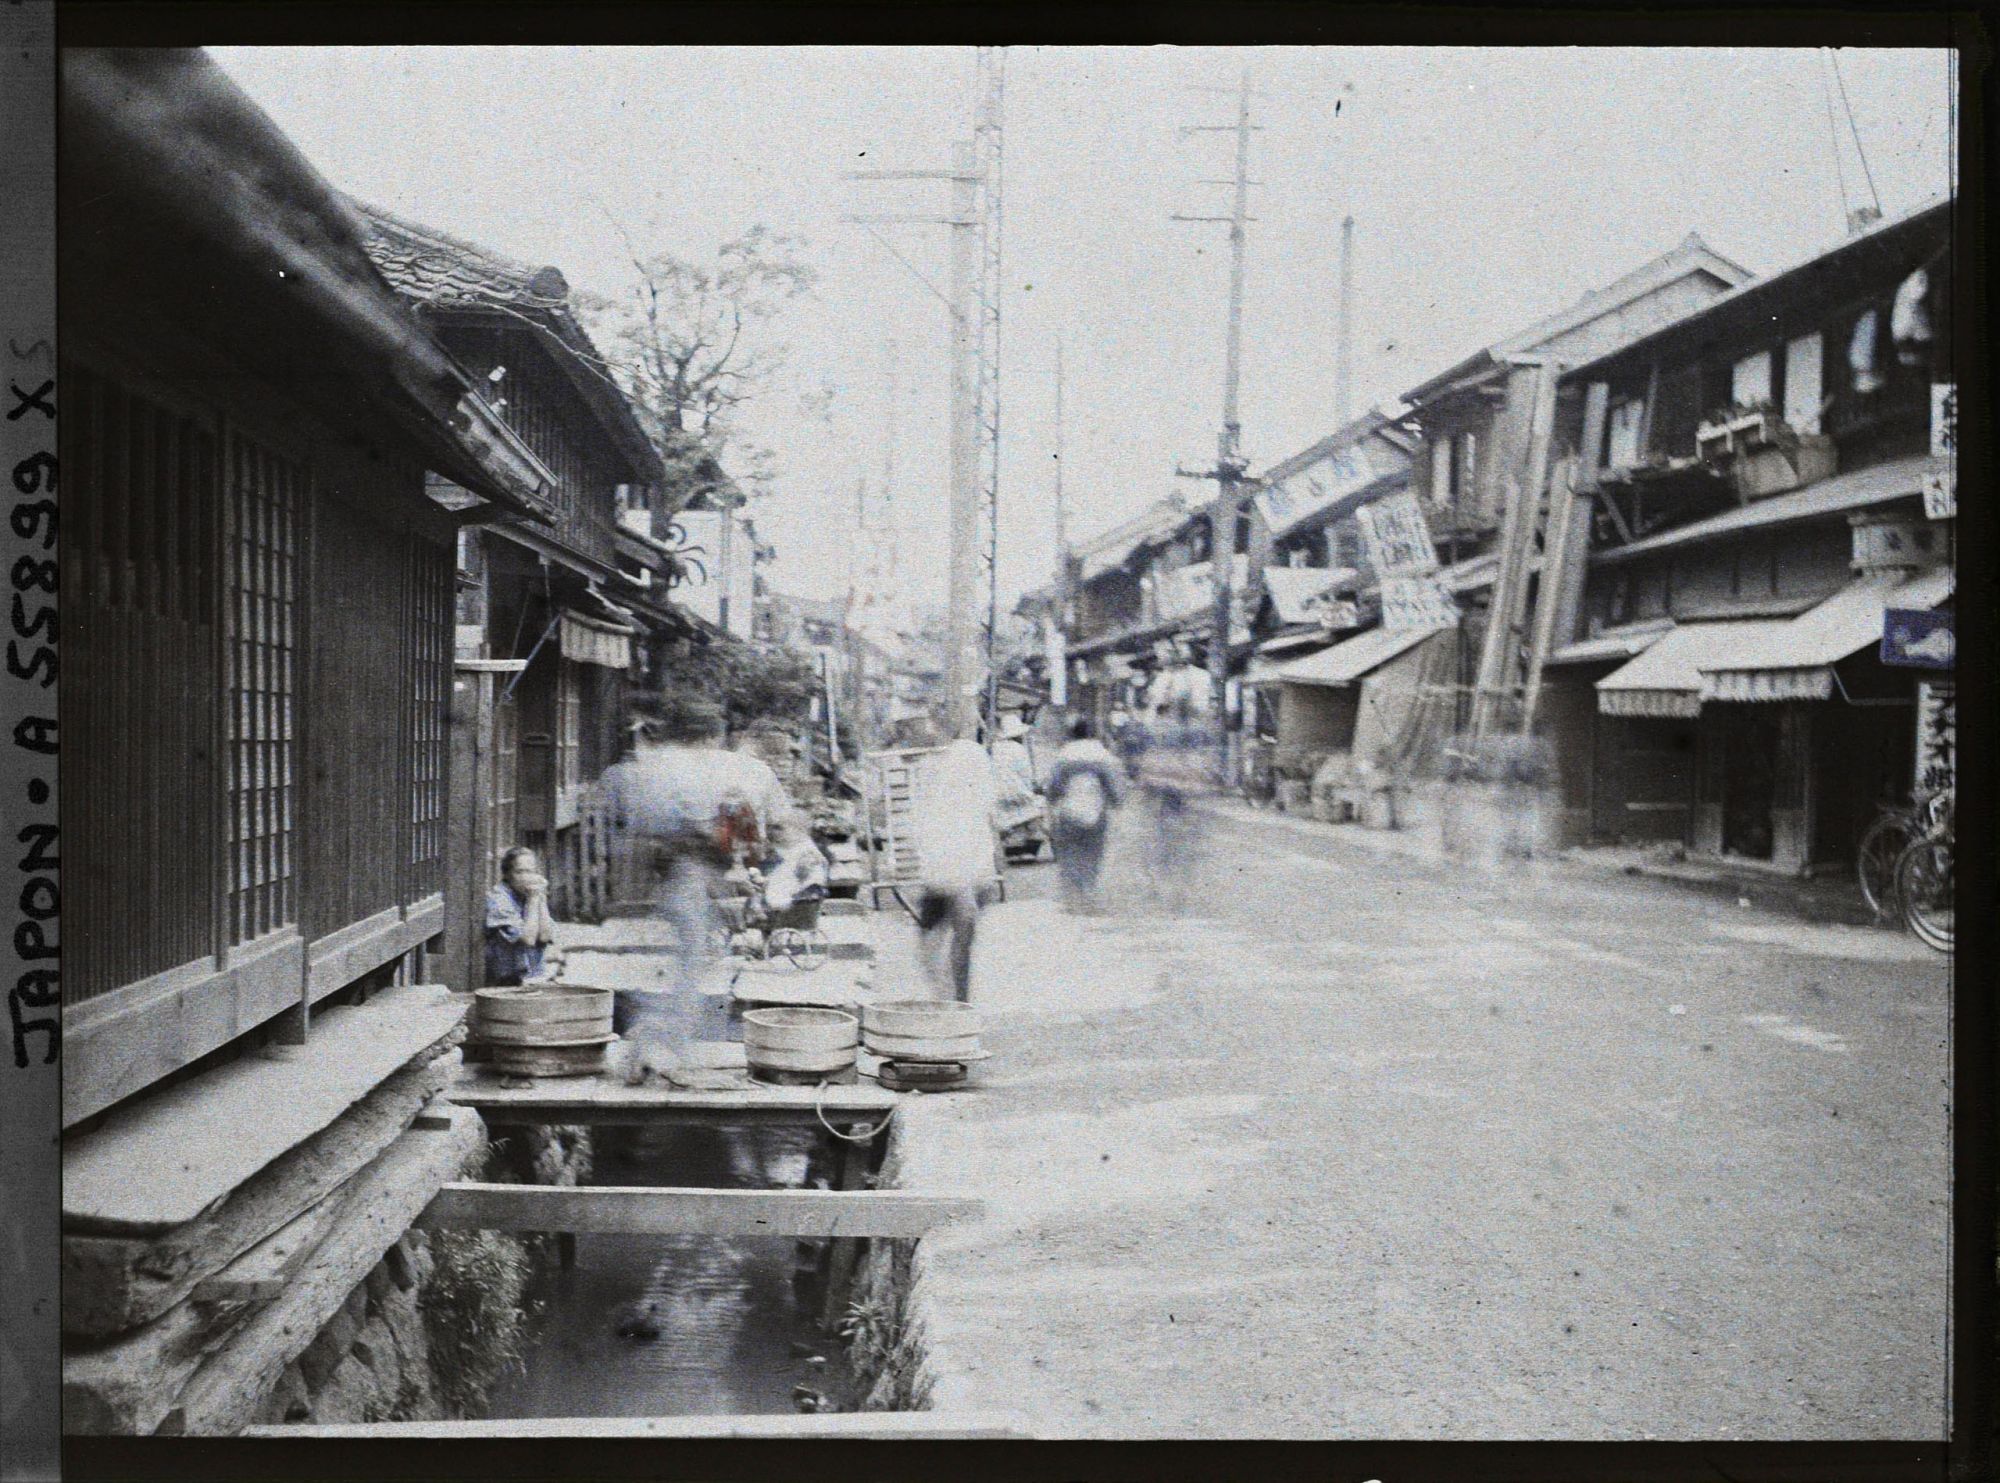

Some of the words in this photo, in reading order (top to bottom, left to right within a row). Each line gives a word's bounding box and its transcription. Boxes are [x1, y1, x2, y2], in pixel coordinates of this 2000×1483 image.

[7, 452, 59, 689] 55899
[13, 716, 59, 754] A
[8, 824, 60, 1068] JAPON
